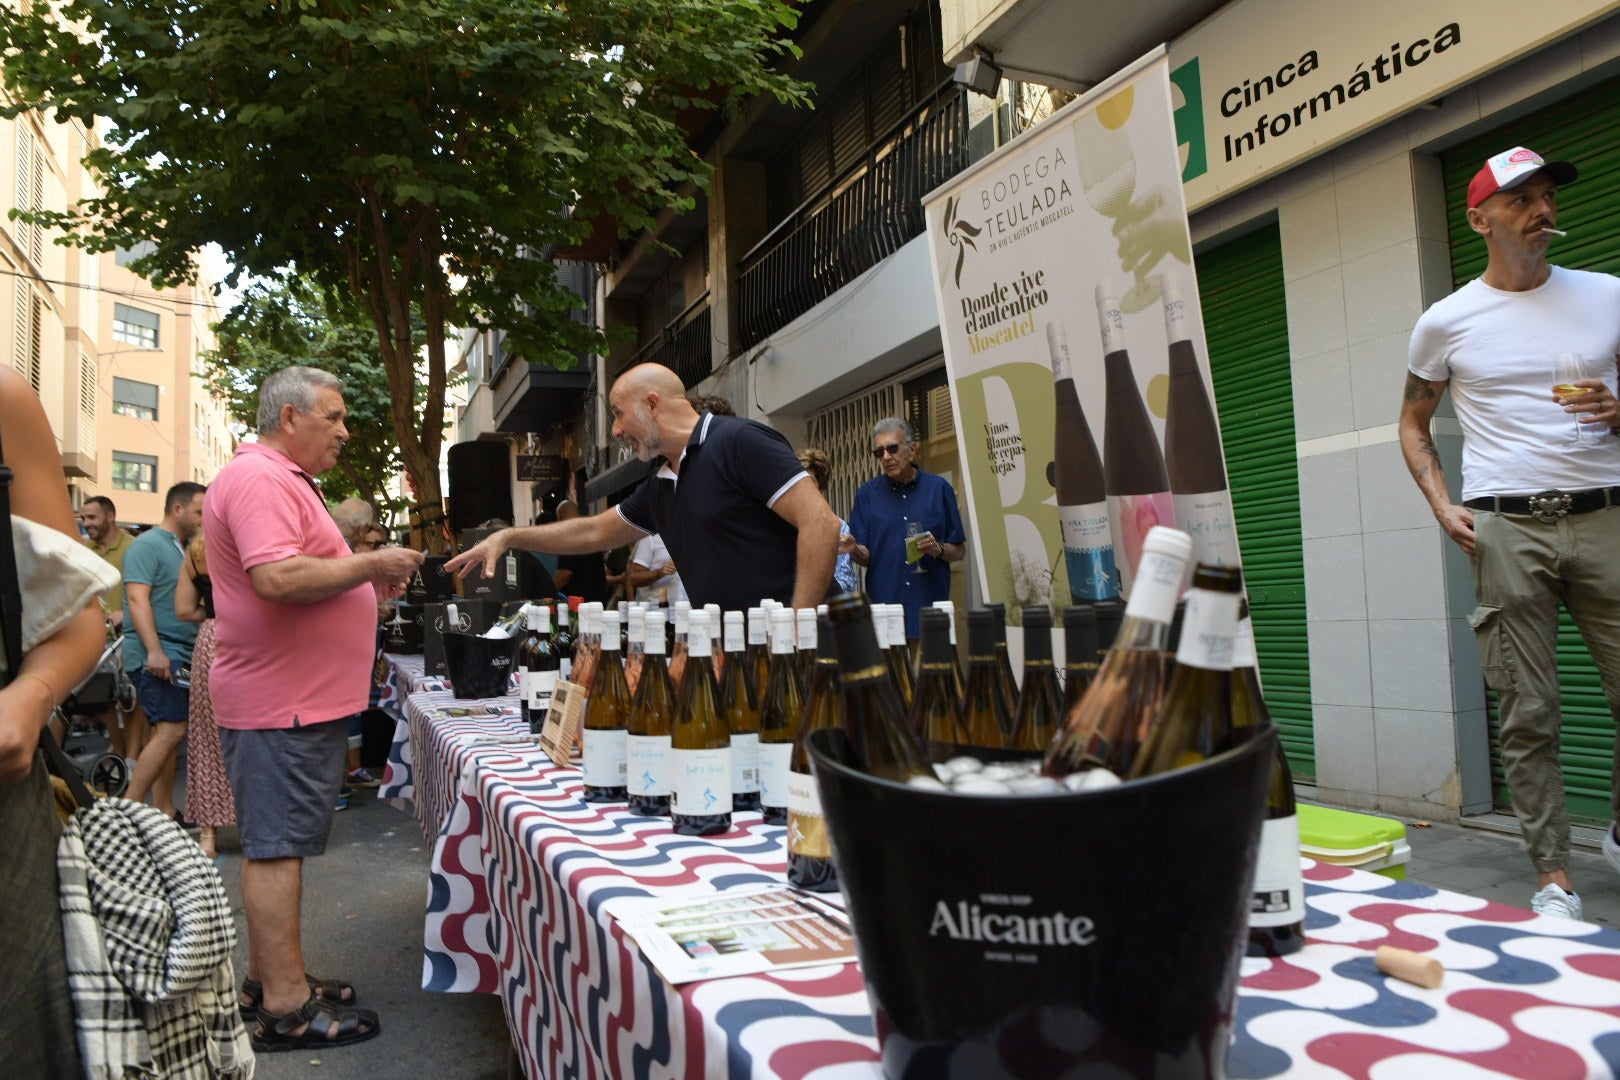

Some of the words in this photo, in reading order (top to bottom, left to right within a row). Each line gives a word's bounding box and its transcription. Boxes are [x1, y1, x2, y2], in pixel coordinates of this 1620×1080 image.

[1220, 49, 1320, 118] Cinca
[1223, 22, 1462, 163] Informática
[981, 147, 1067, 211] BODEGA
[985, 179, 1072, 238] TEULADA
[961, 282, 1009, 318] Donde
[1012, 270, 1044, 296] vive
[965, 311, 978, 335] el
[967, 309, 1035, 355] Moscatel
[983, 422, 1009, 435] Vinos
[986, 434, 1022, 450] Blancos
[990, 459, 1016, 476] viejas
[928, 900, 1098, 946] Alicante
